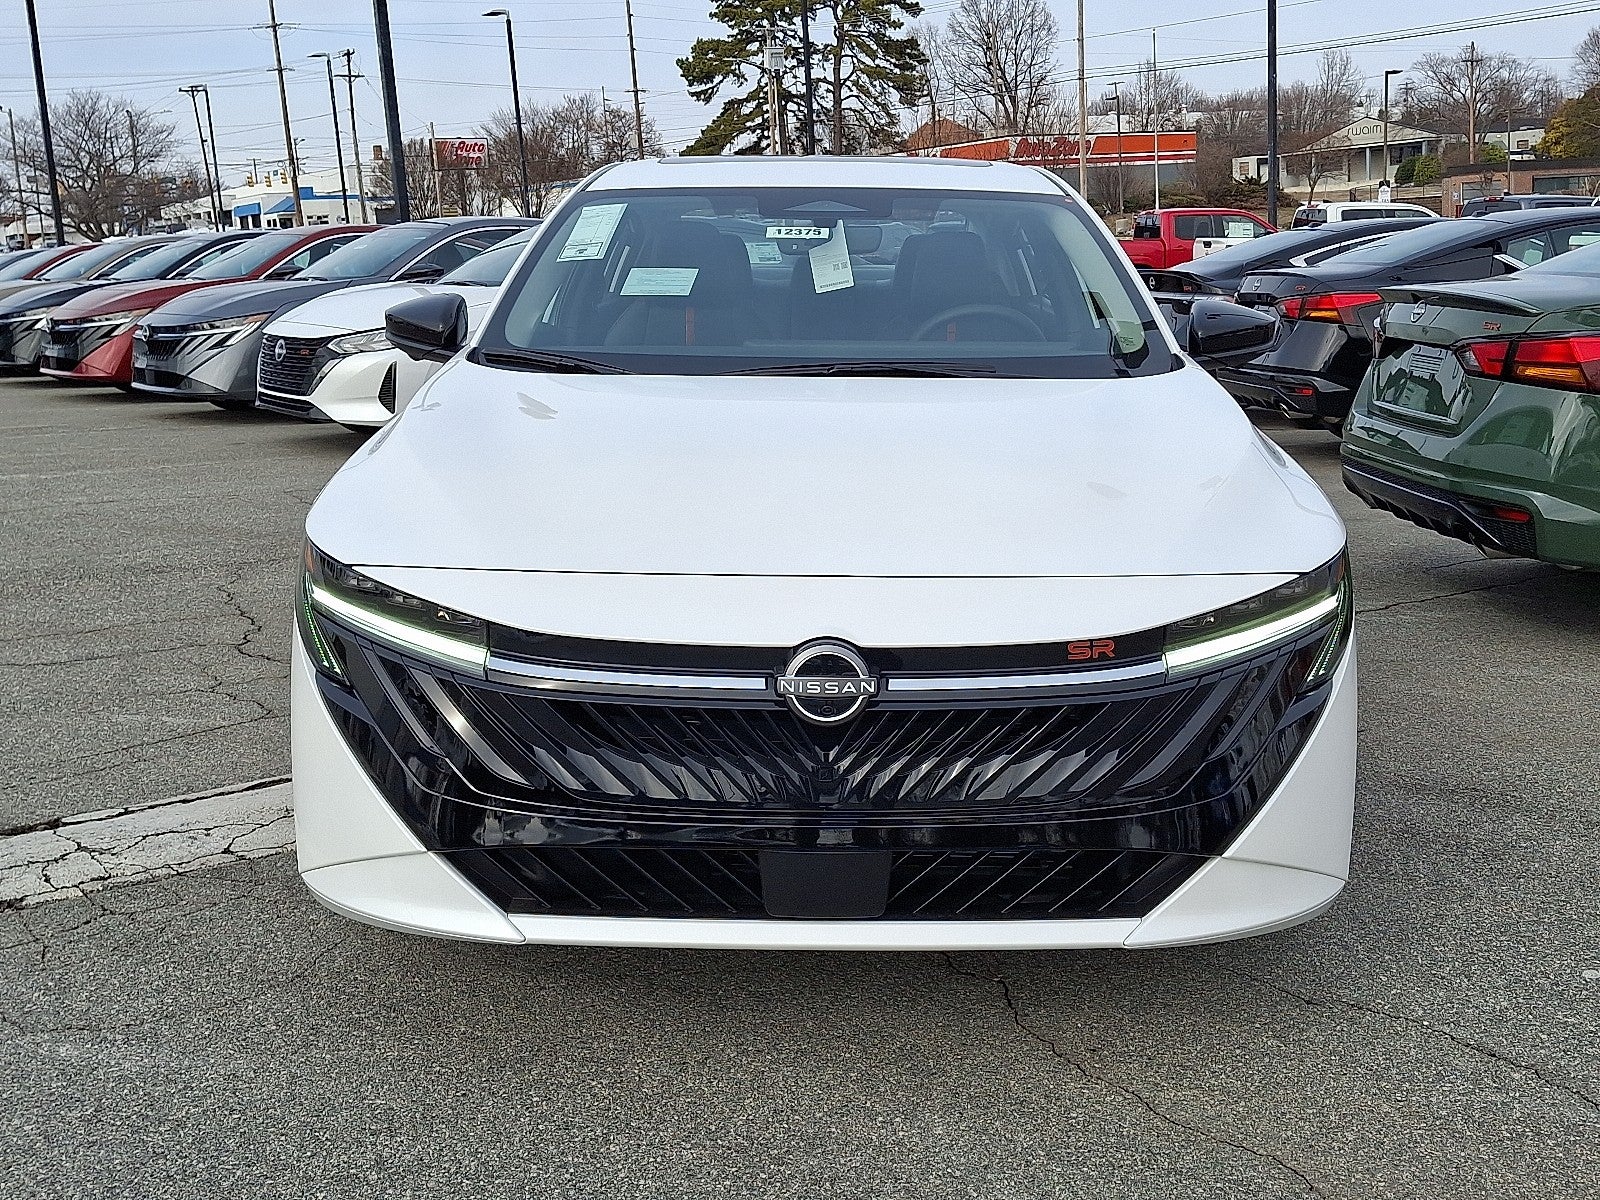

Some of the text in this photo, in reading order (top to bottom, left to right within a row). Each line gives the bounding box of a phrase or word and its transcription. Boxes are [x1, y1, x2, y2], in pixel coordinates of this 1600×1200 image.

[456, 141, 486, 153] Auto
[775, 228, 822, 236] 12375
[1067, 640, 1116, 660] SR
[780, 680, 875, 694] NISSAN
